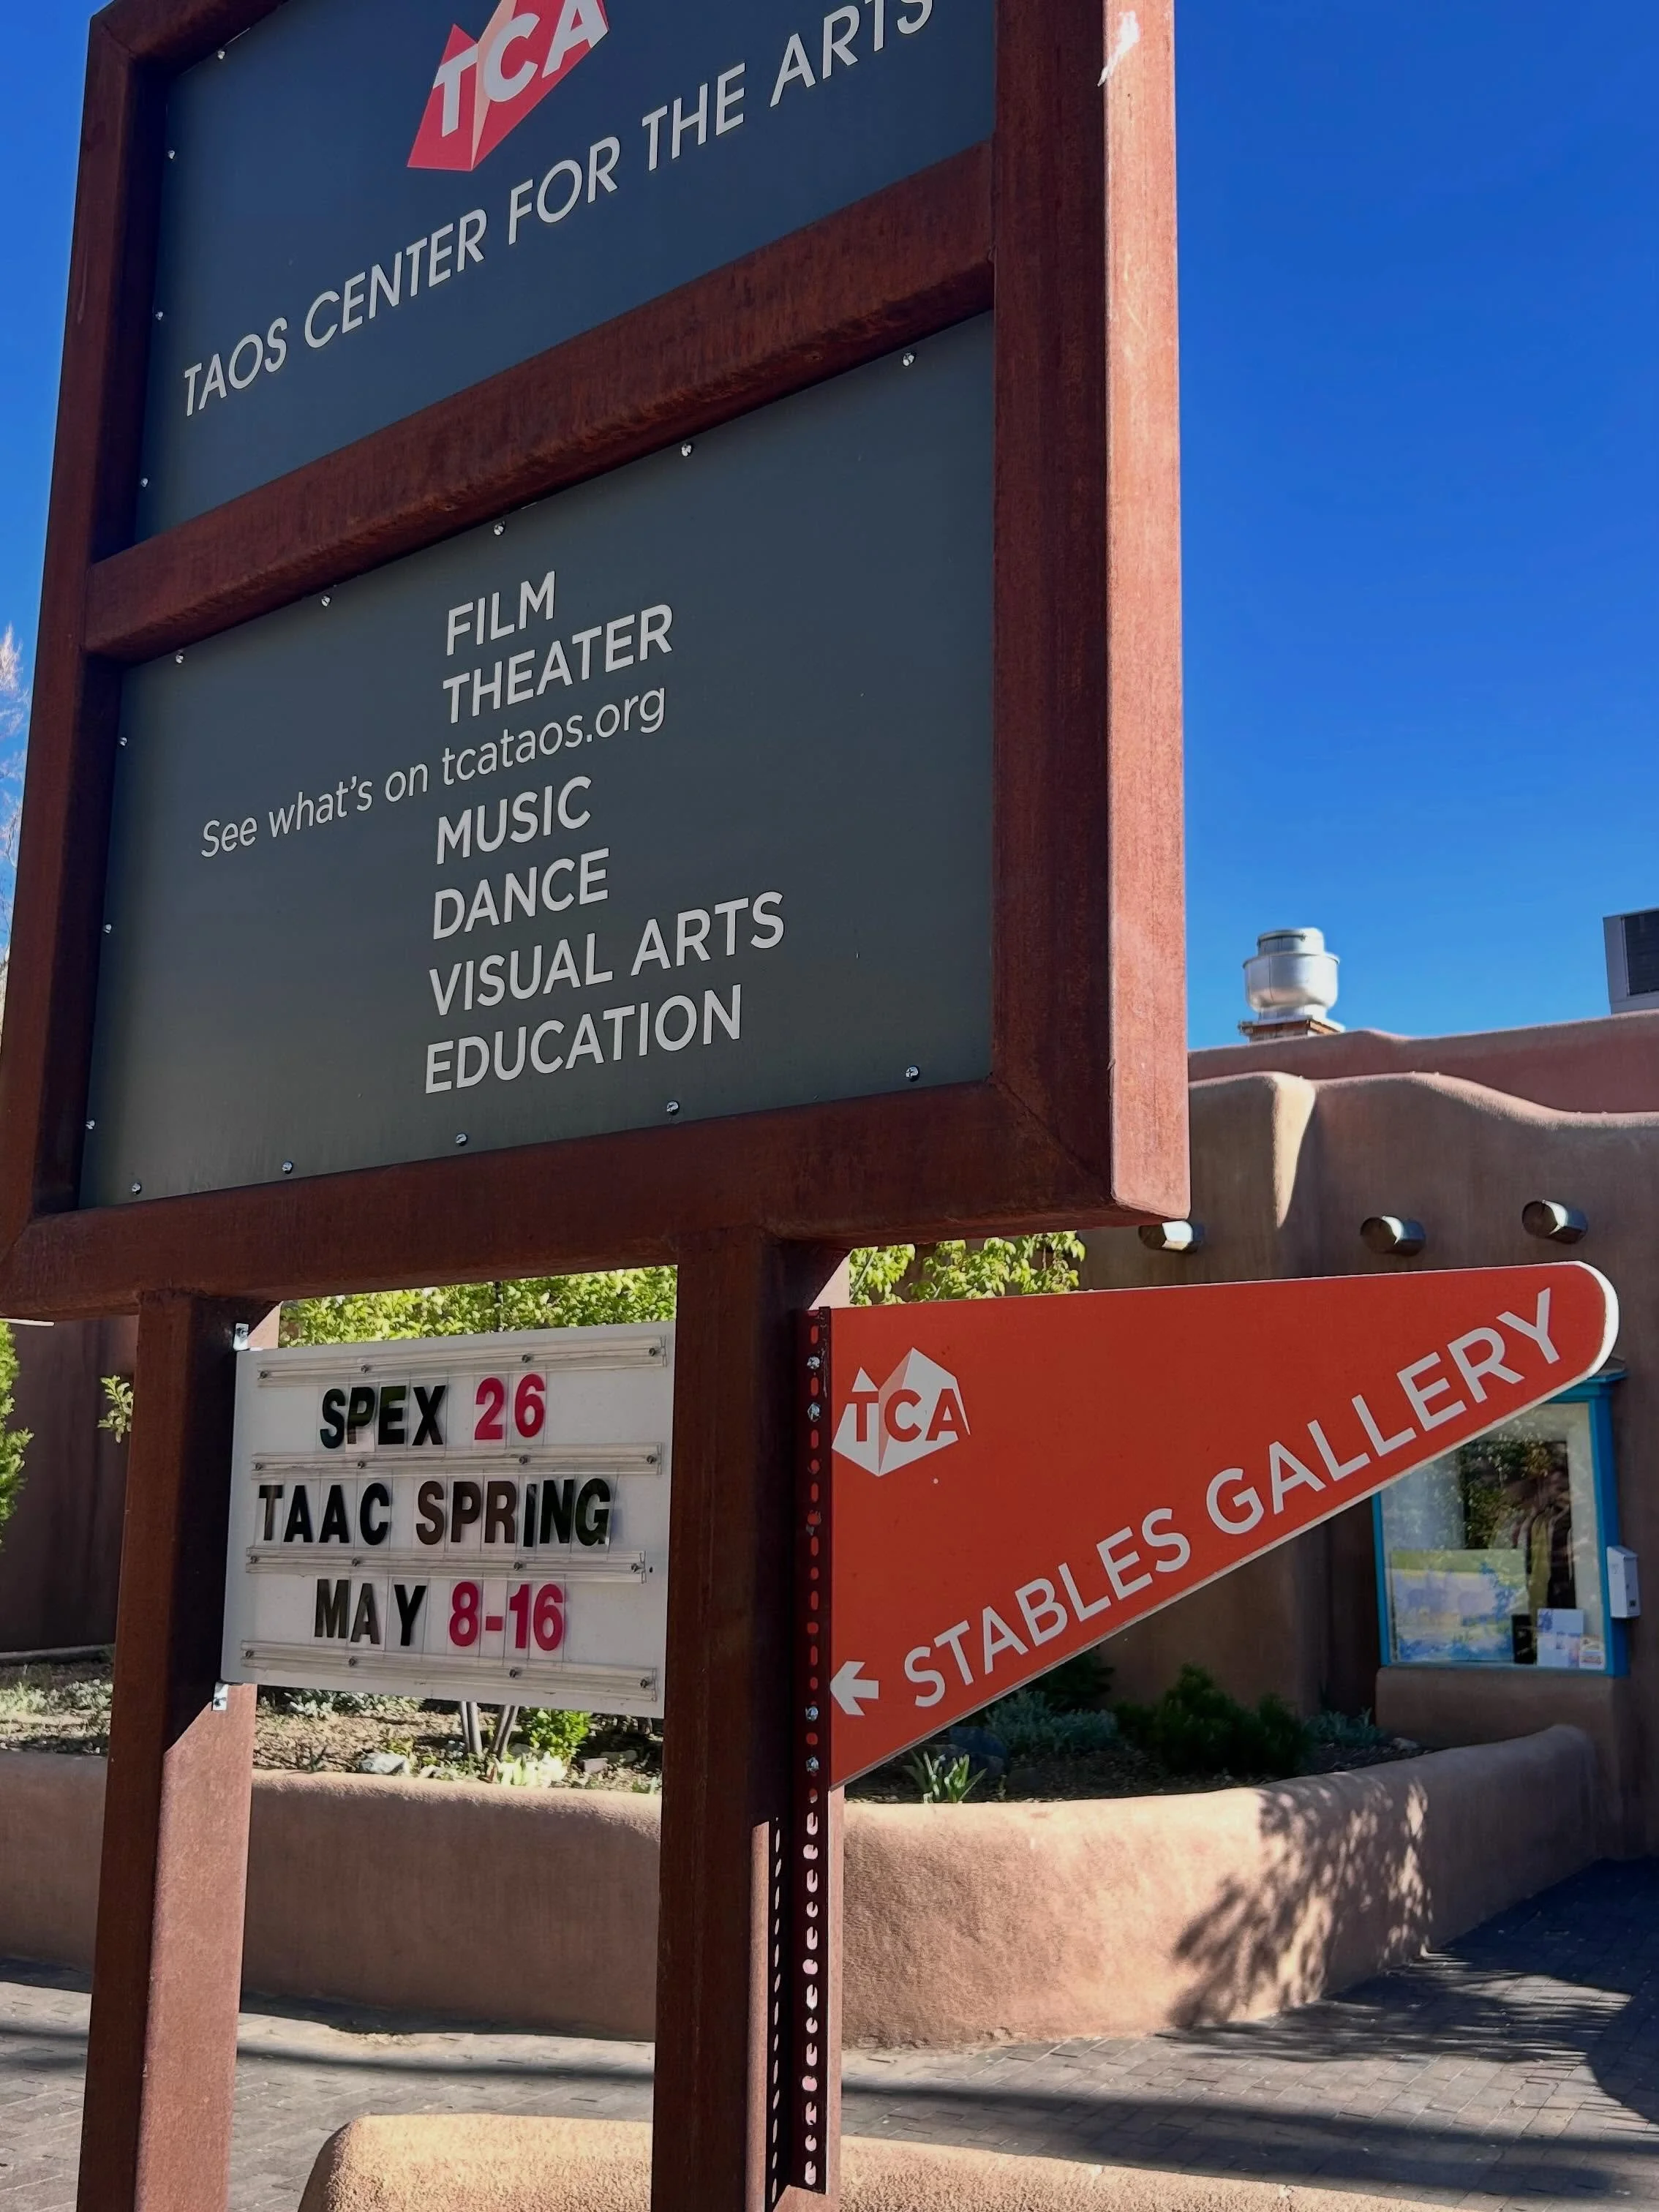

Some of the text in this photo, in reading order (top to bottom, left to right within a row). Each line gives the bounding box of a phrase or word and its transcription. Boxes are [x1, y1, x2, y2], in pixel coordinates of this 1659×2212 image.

[433, 0, 609, 138] TCA
[184, 316, 288, 417] TAOS
[304, 208, 487, 348] CENTER
[508, 136, 620, 246] FOR
[642, 62, 745, 171] THE
[446, 571, 557, 655] FILM
[443, 604, 672, 723] THEATER
[201, 688, 666, 857] See what's on tcataos.org
[437, 776, 592, 865] MUSIC
[433, 849, 609, 940] DANCE
[429, 892, 784, 1016] VISUAL ARTS
[425, 985, 741, 1094] EDUCATION
[320, 1373, 546, 1449] SPEX 26
[846, 1388, 967, 1442] TCA
[258, 1478, 612, 1548] TAAC SPRING
[904, 1287, 1560, 1708] STABLES GALLERY
[314, 1579, 565, 1652] MAY 8-16
